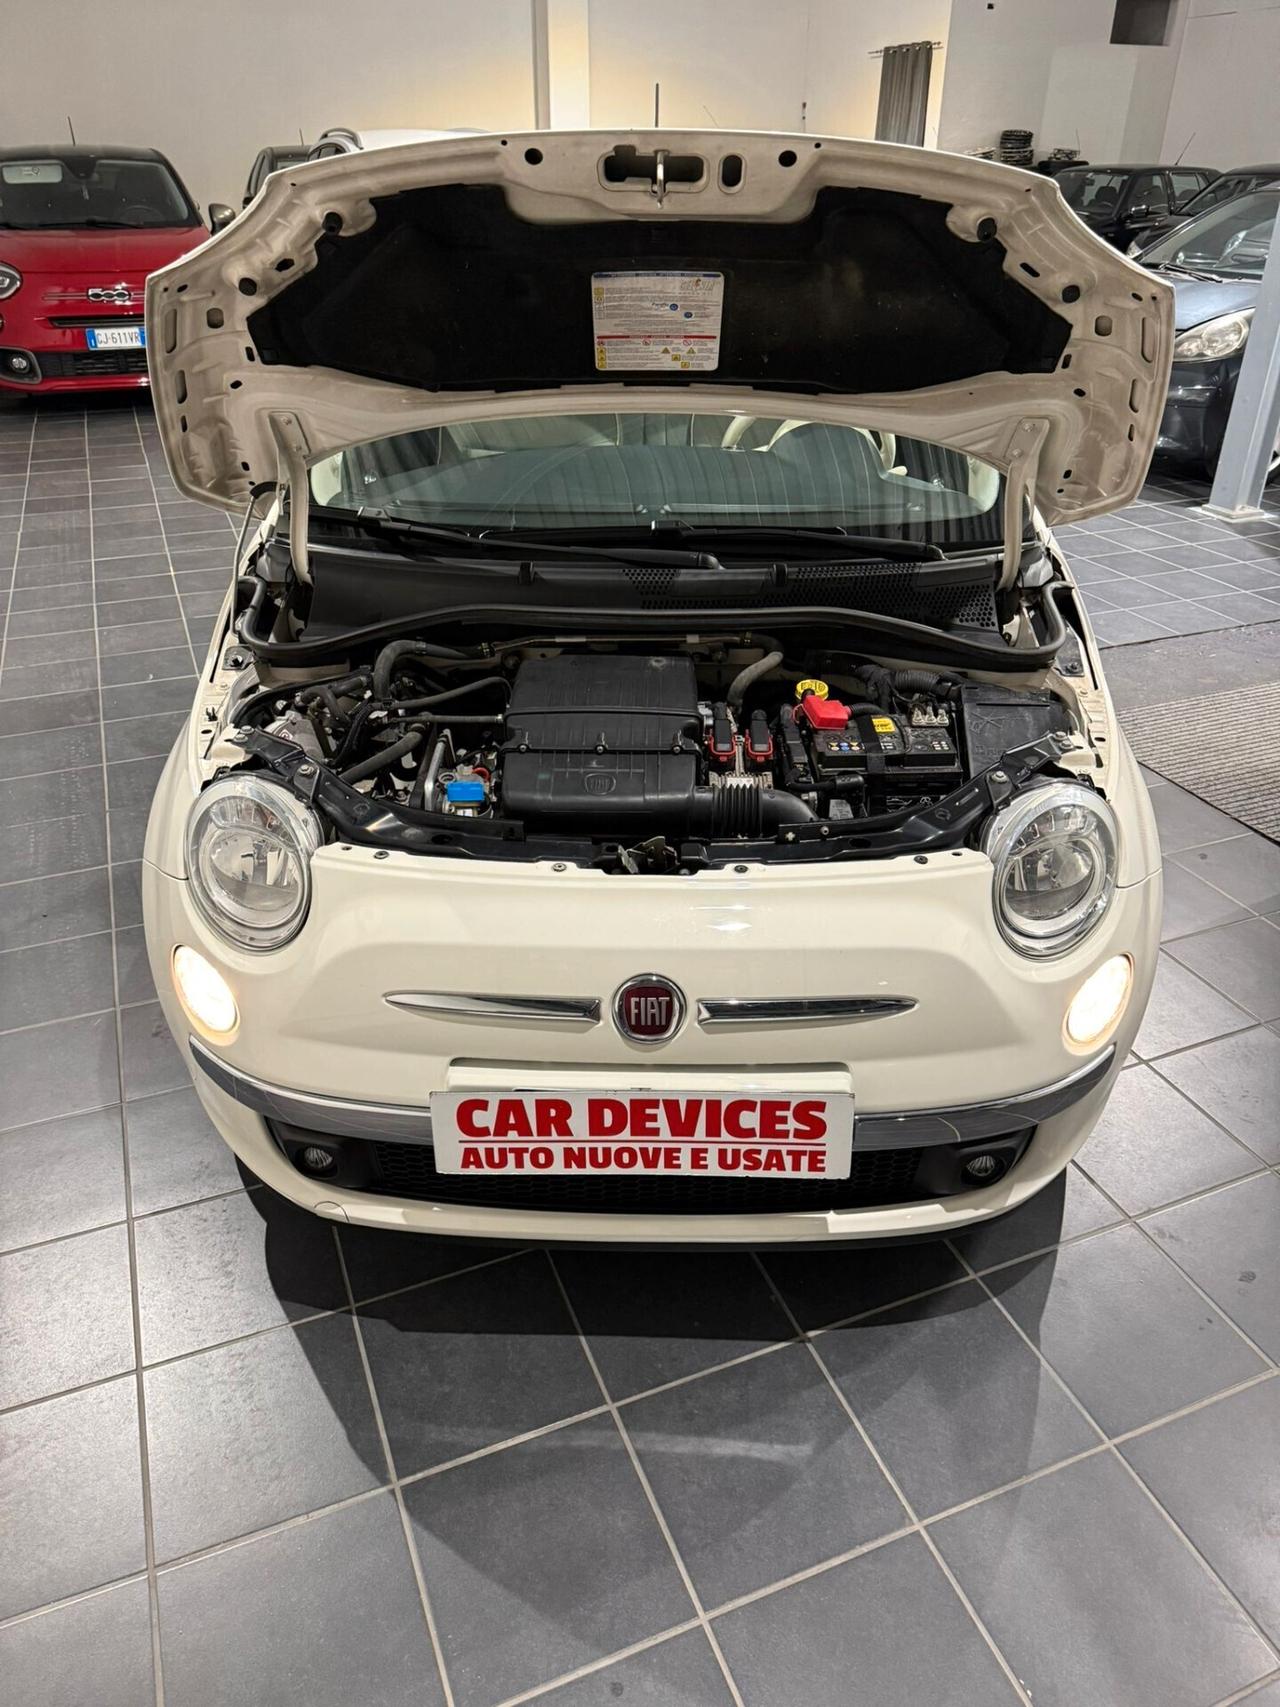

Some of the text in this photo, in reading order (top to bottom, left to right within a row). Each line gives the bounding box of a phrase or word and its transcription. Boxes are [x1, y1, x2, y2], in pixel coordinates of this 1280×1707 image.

[630, 997, 670, 1026] FIAT
[456, 1098, 827, 1140] CAR DEVICES
[460, 1146, 826, 1172] AUTO NUOVE E USATE
